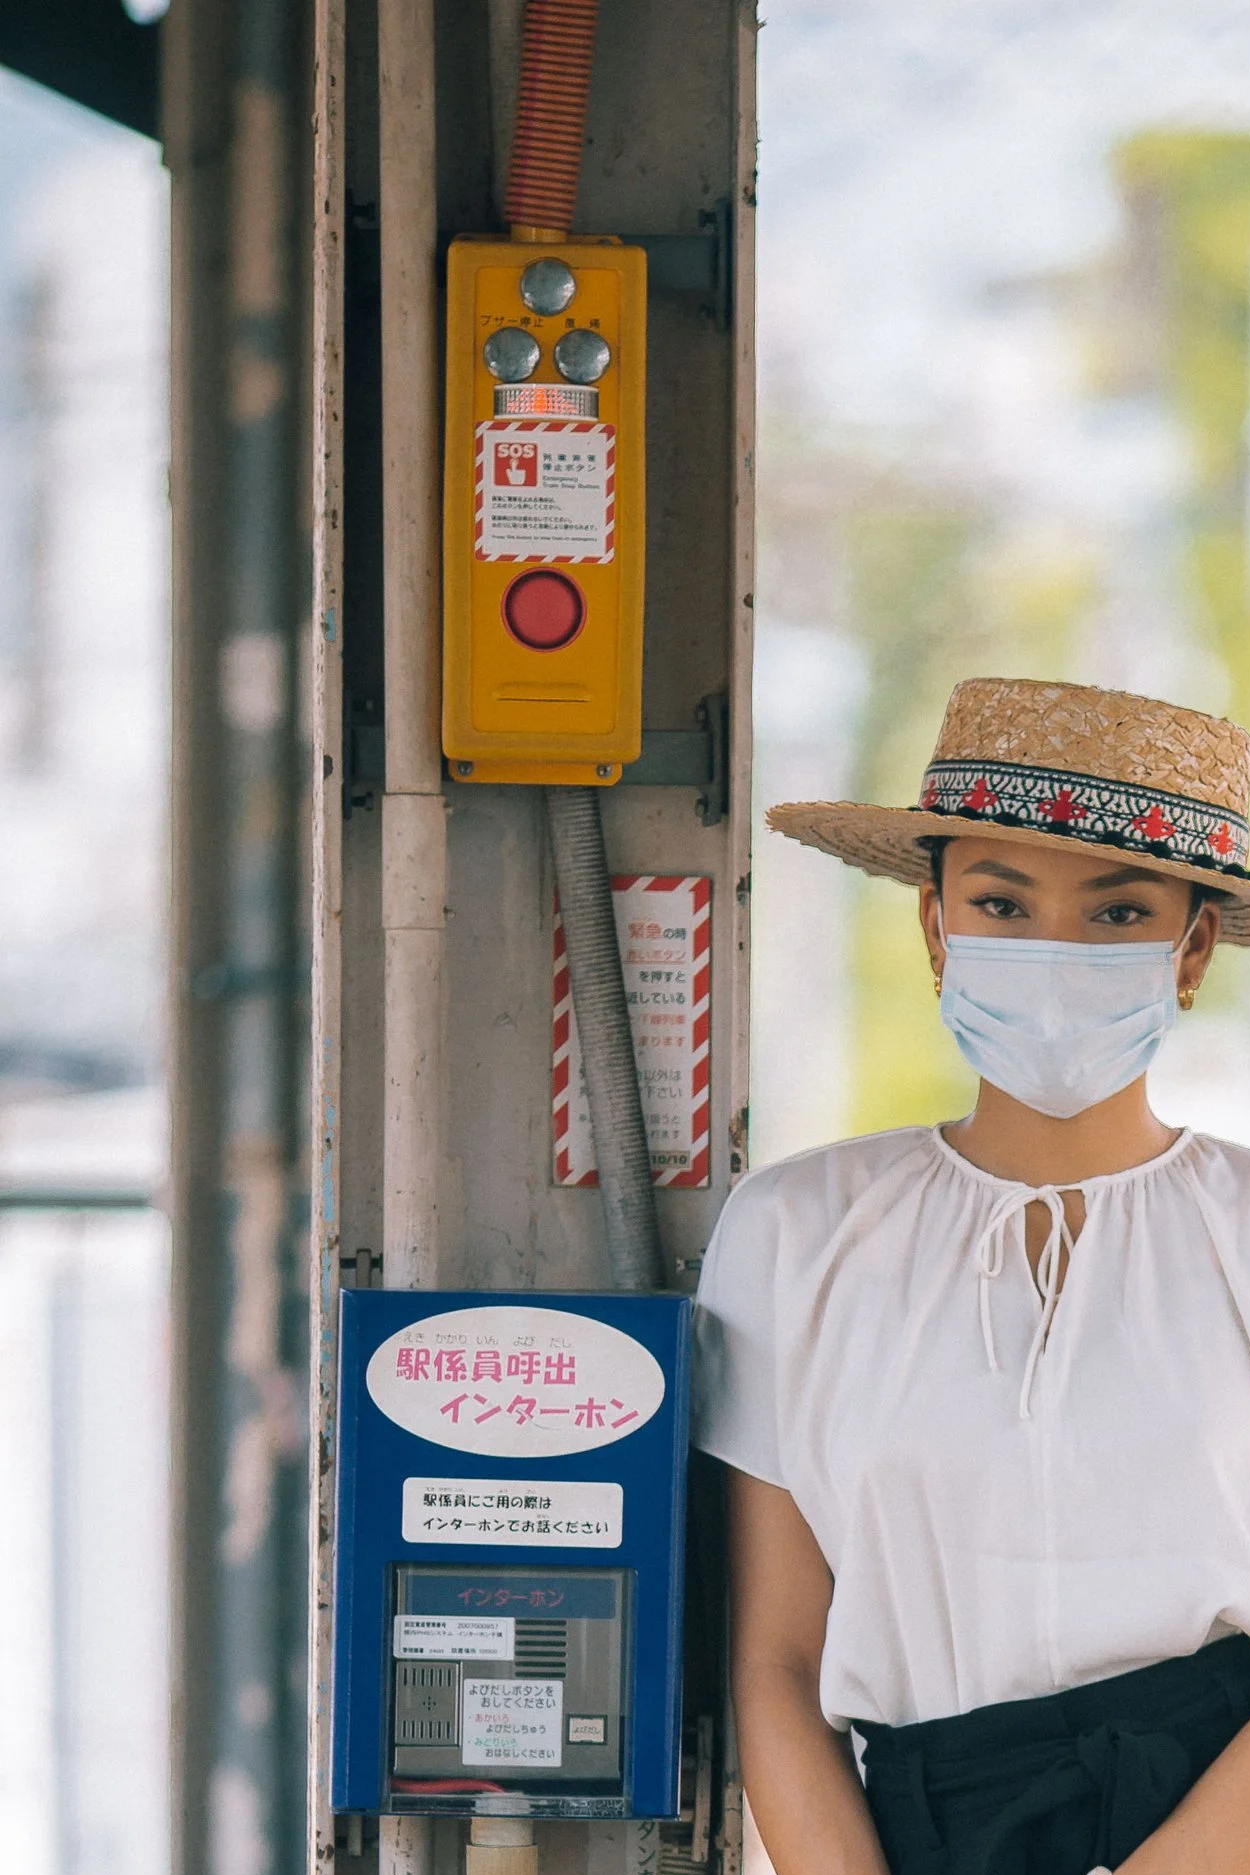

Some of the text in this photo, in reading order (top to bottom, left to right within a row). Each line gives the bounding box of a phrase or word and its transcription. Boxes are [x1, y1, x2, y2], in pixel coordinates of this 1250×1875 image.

[497, 443, 535, 458] SOS
[543, 463, 597, 472] 停止ボタン
[628, 922, 687, 940] 緊急の時
[639, 970, 686, 983] を押すと
[638, 1069, 682, 1081] 以外は
[403, 1333, 572, 1348] えき かかり いん よび だし
[396, 1347, 576, 1386] 駅係員呼出
[439, 1392, 640, 1430] インターホン
[423, 1493, 552, 1510] 駅係員にご用の際は
[423, 1517, 609, 1535] インターホンでお話ください
[457, 1588, 564, 1608] インターホン
[469, 1684, 554, 1697] よびだしボタンを
[481, 1697, 556, 1709] おしてください
[475, 1713, 511, 1724] あかいろ
[486, 1724, 547, 1735] よびだしちゅう
[573, 1726, 601, 1735] よびだし
[474, 1737, 520, 1748] みどりいろ
[485, 1748, 556, 1760] おはなしください
